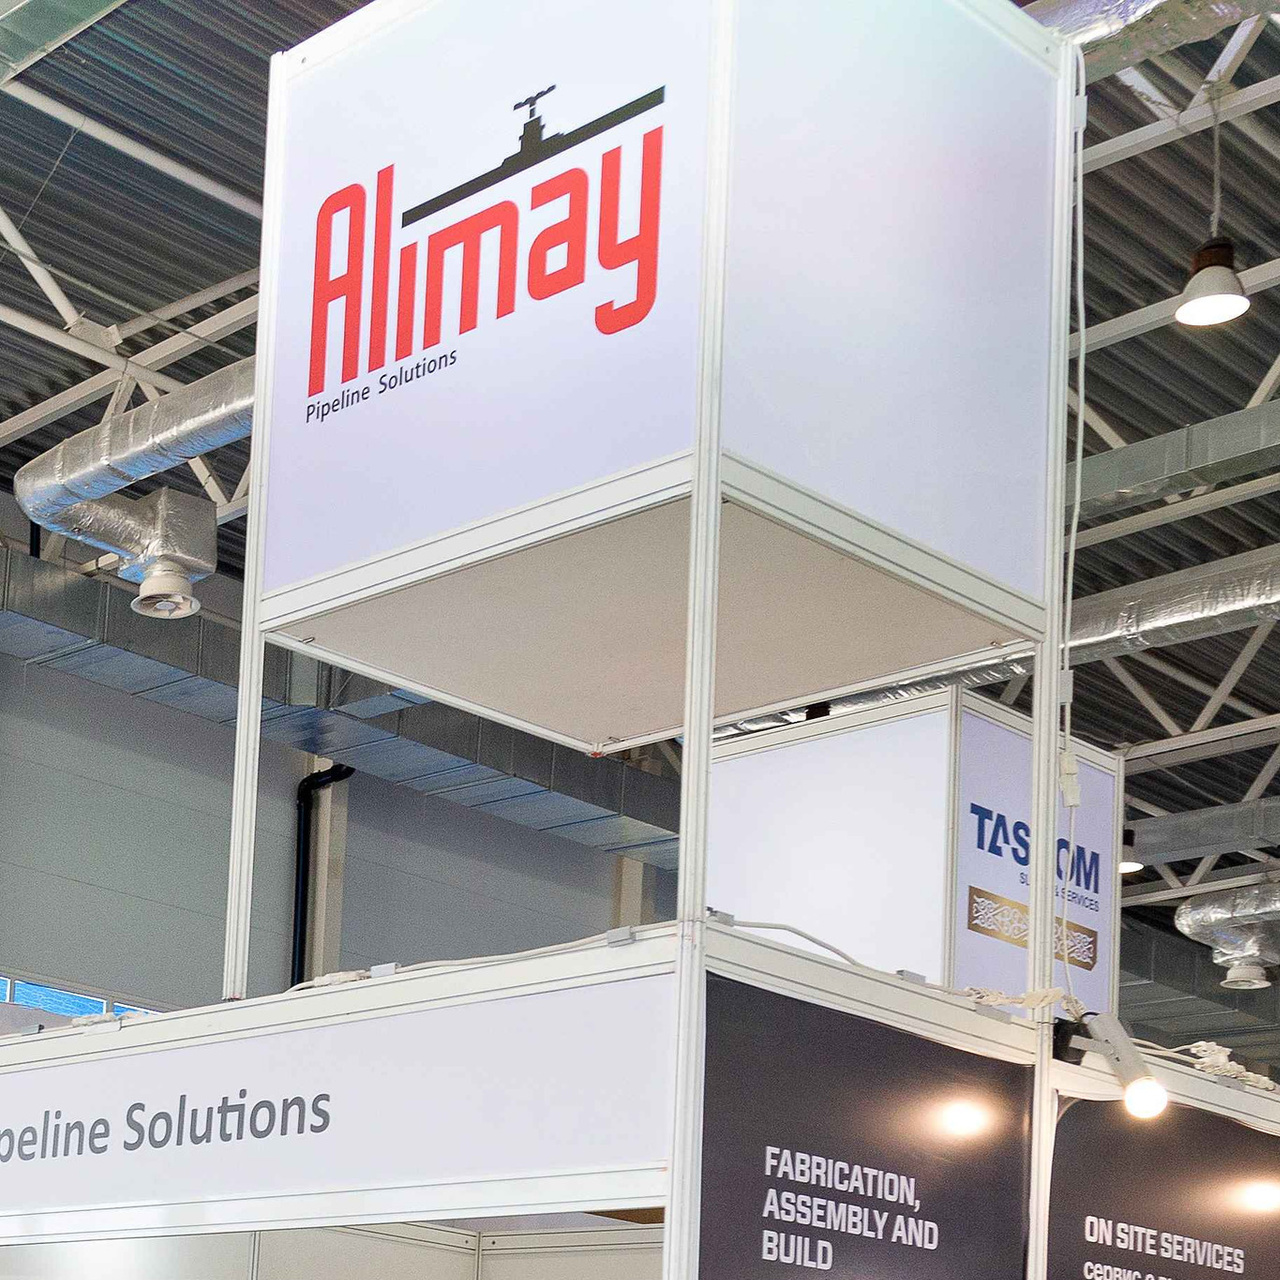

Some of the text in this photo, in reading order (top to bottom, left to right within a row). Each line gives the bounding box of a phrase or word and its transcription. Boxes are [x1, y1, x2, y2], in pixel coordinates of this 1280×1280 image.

[308, 125, 664, 397] Alimay
[306, 349, 457, 423] Pipeline Solutions
[971, 802, 1099, 894] TASOM
[1061, 888, 1099, 912] SERVICES
[124, 1089, 331, 1150] Solutions
[765, 1146, 920, 1212] FABRICATION,
[762, 1188, 939, 1250] ASSEMBLY AND
[762, 1230, 833, 1270] BUILD
[1085, 1216, 1245, 1274] ON SITE SERVICES
